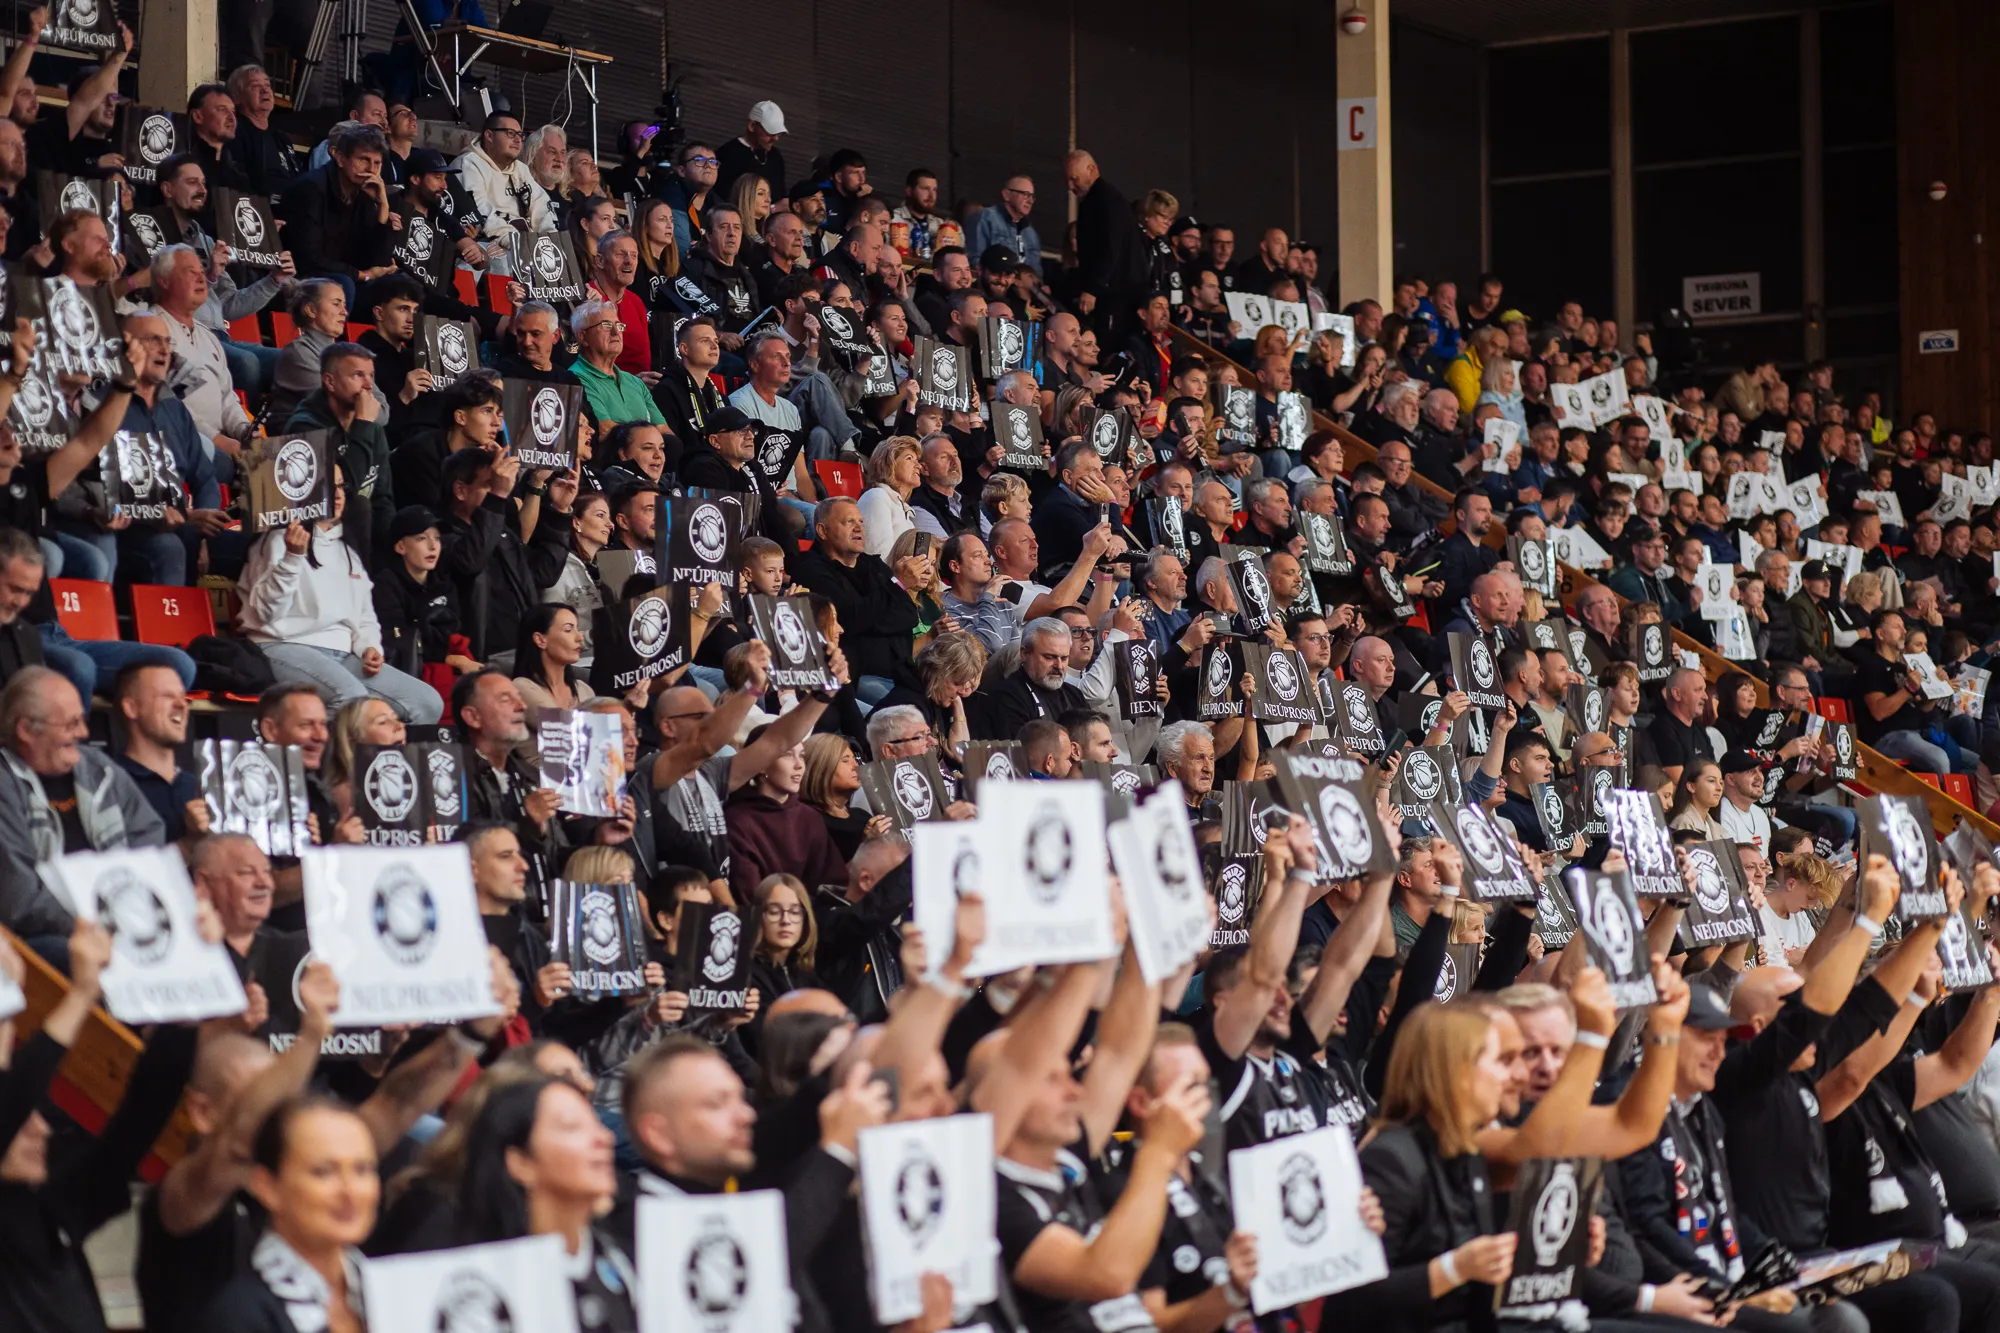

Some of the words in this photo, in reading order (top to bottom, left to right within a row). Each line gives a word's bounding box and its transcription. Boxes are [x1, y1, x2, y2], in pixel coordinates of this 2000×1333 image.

[55, 27, 116, 48] NEÚPROSNÍ
[1350, 105, 1365, 142] C
[529, 283, 580, 301] NEÚPROSNÍ
[1694, 279, 1749, 293] TRIBÚNA
[1693, 295, 1752, 314] SEVER
[518, 446, 571, 468] NEÚPROSNÍ
[833, 470, 848, 485] 12
[62, 591, 81, 613] 26
[162, 598, 180, 616] 25
[614, 646, 683, 689] NEÚPROSNÍ
[1264, 702, 1317, 722] NEÚPROSNÍ
[270, 1031, 381, 1055] NEROSNÍ
